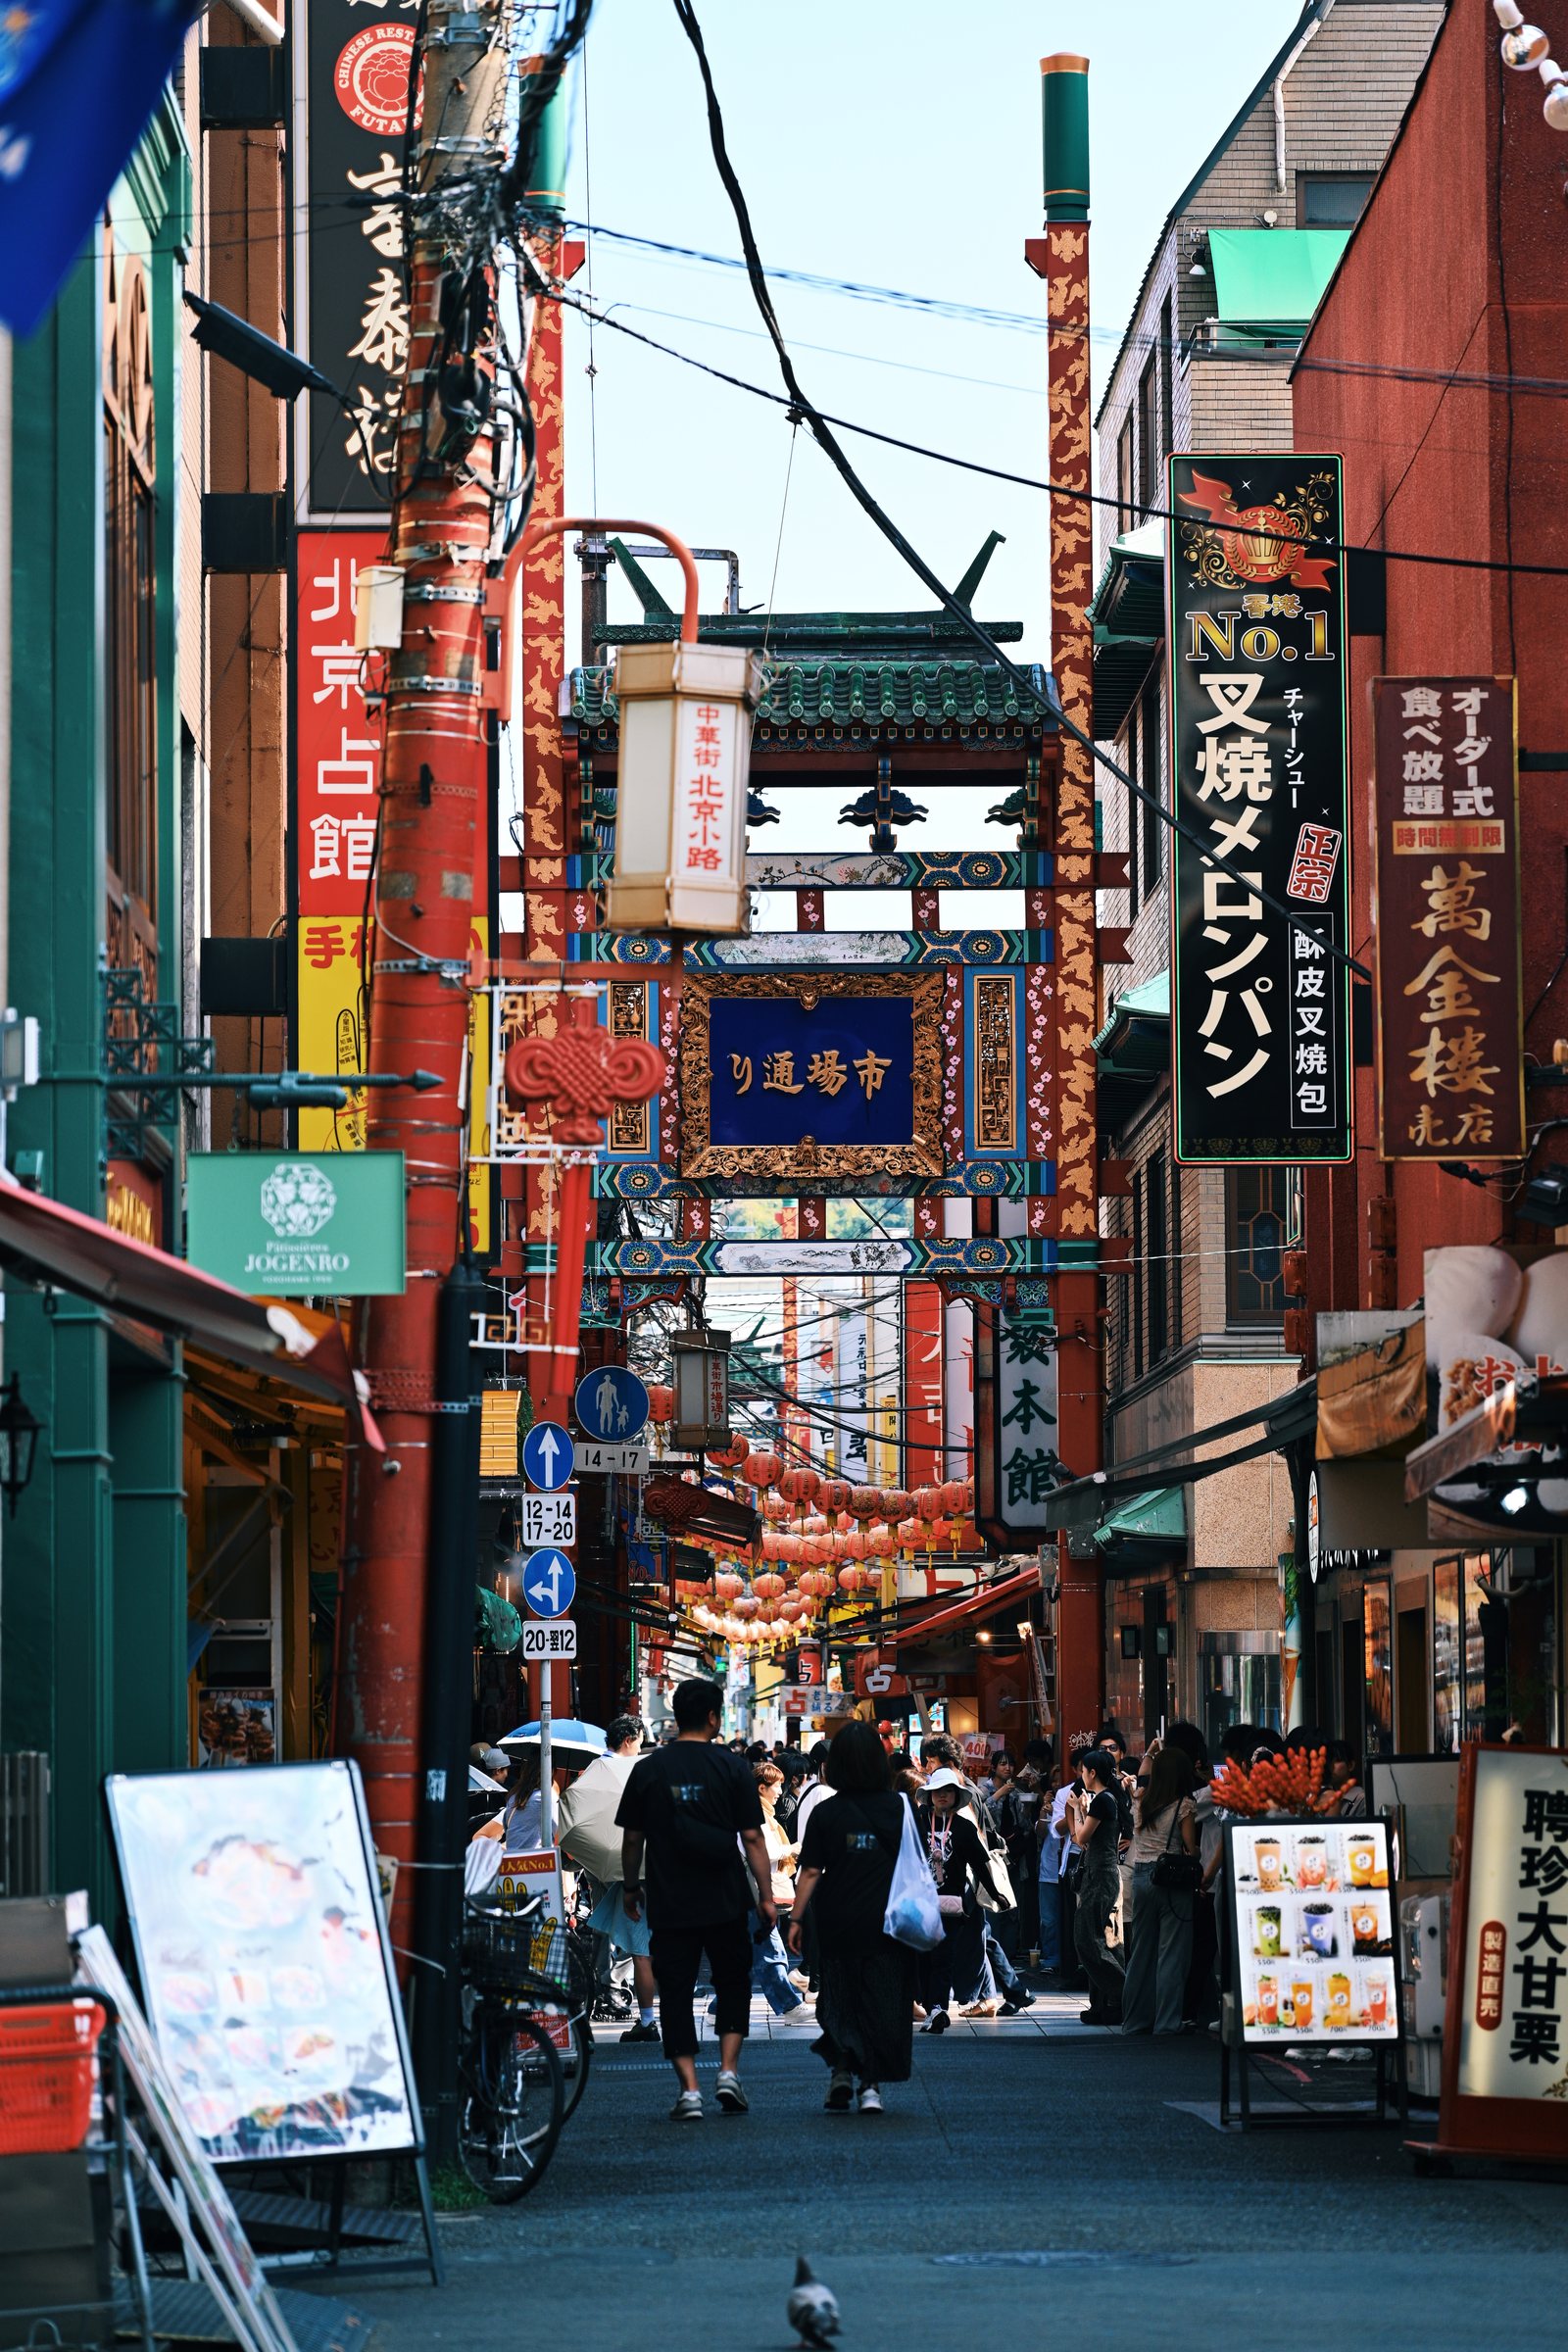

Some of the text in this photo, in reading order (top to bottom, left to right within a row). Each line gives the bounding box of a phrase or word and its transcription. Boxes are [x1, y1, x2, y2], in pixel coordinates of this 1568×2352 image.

[339, 31, 373, 88] CHINESE
[1242, 594, 1303, 618] 香港
[1186, 611, 1335, 662] No.1
[1283, 687, 1305, 808] チャーシュー
[1400, 686, 1445, 815] 食べ放題
[1451, 687, 1494, 816] オーダー式
[1396, 826, 1501, 848] 時間無制限
[1195, 672, 1273, 1100] 叉焼メロンパン
[245, 1253, 350, 1273] JOGENRO
[526, 1500, 572, 1520] 12-14
[527, 1522, 573, 1541] 17-20
[525, 1630, 574, 1652] 20-翌12
[785, 1689, 807, 1713] 占
[1509, 1789, 1568, 2065] 聘珍大甘栗
[1480, 1931, 1503, 2018] 製造直売
